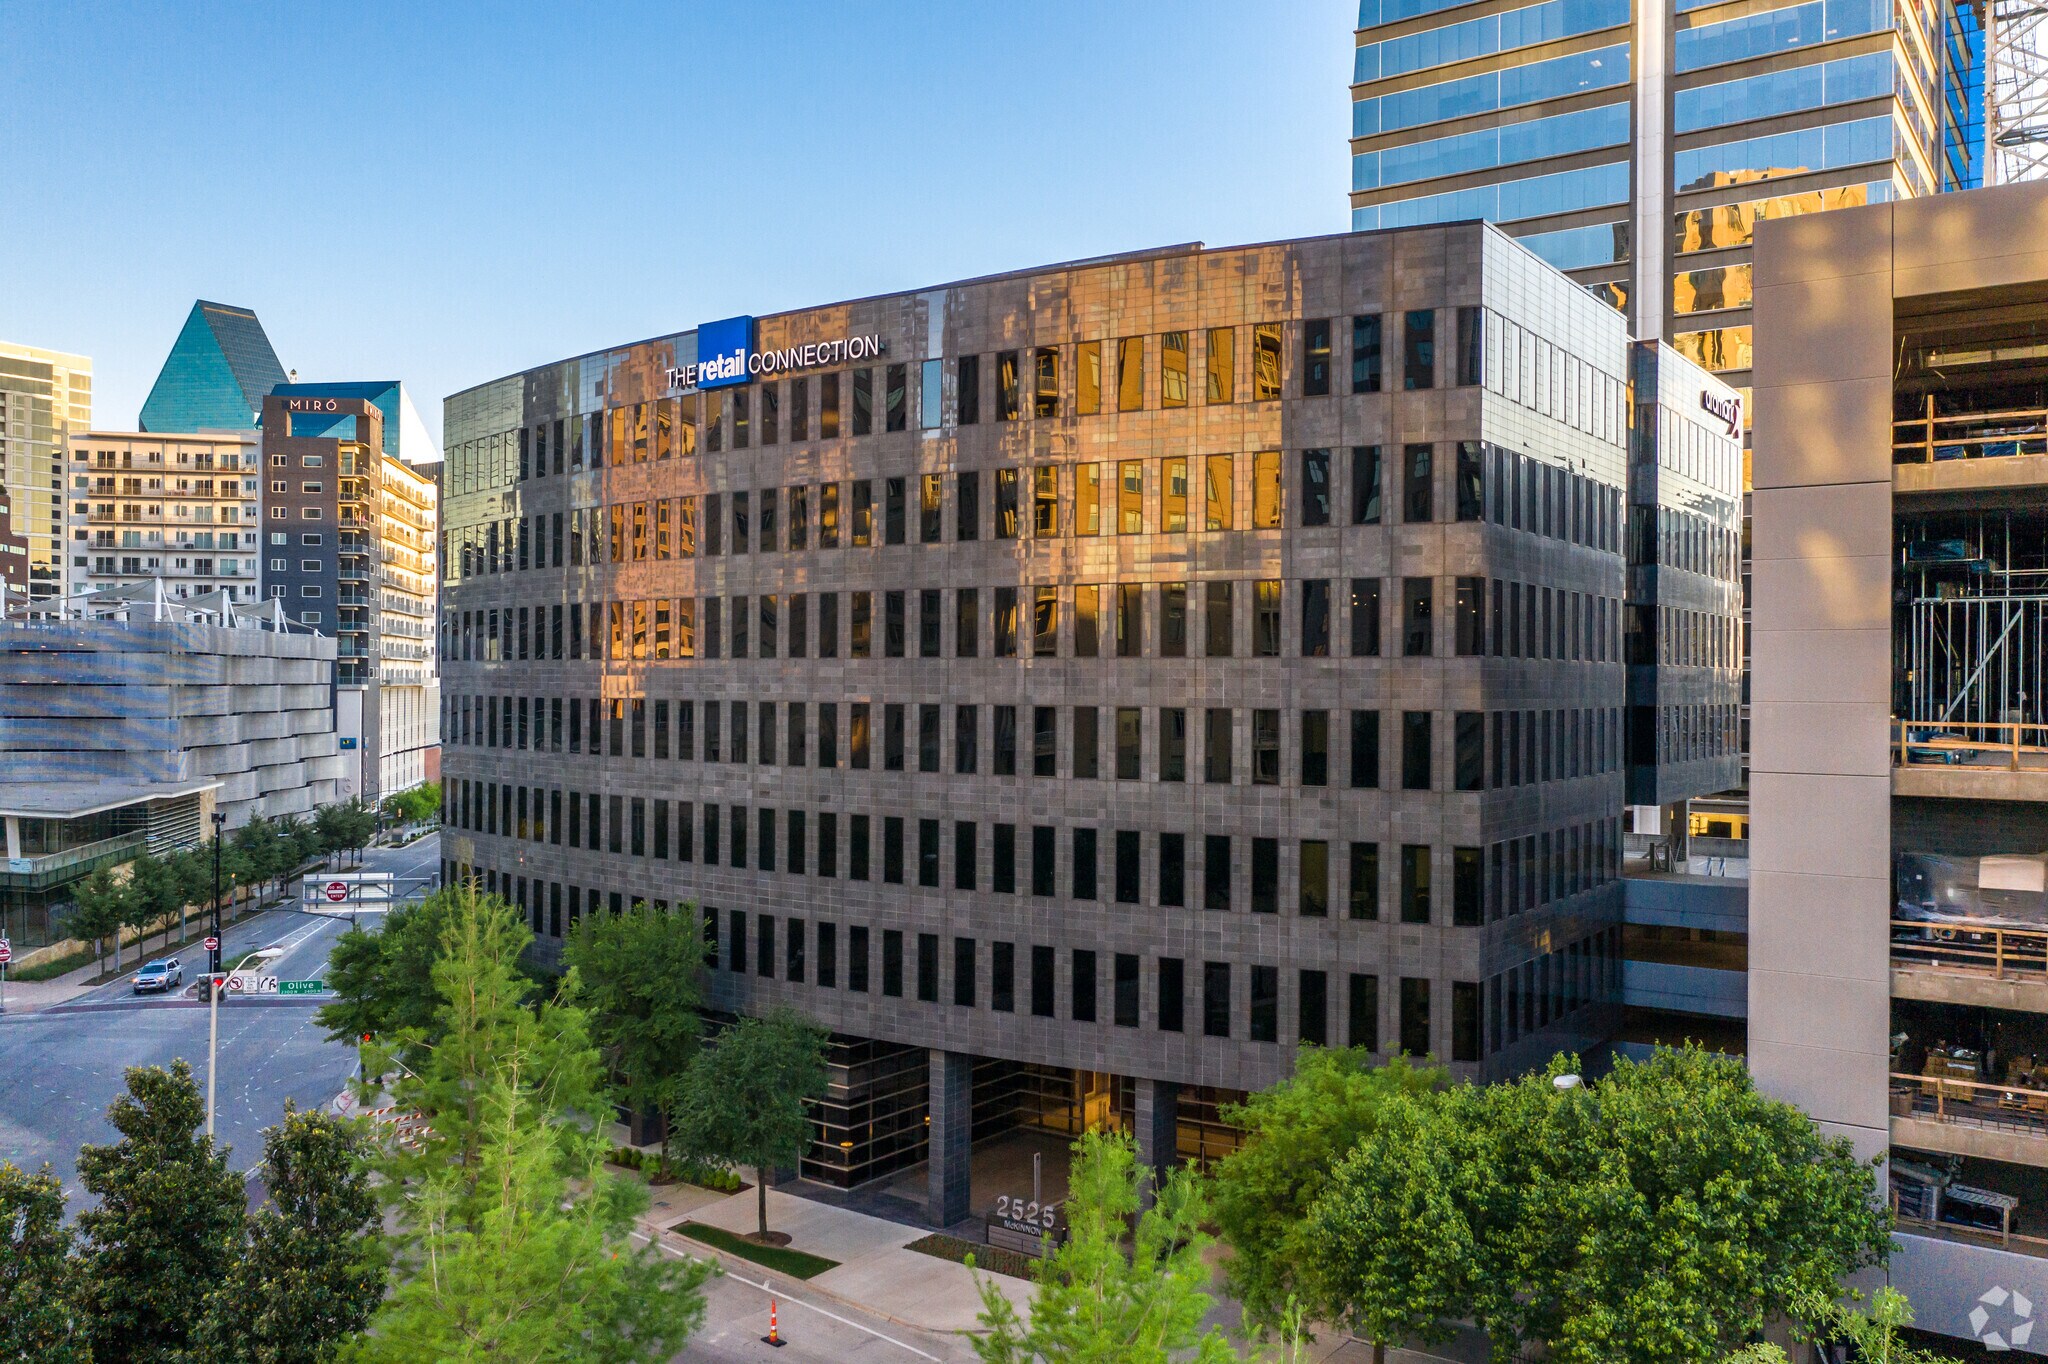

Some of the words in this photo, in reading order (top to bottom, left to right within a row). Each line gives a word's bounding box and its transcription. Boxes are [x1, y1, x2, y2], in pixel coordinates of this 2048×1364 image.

[665, 364, 698, 388] THE
[698, 348, 745, 381] retail
[748, 334, 879, 374] CONNECTION
[289, 398, 337, 411] MIRÓ
[287, 981, 314, 990] Olive
[996, 1195, 1056, 1228] 2525
